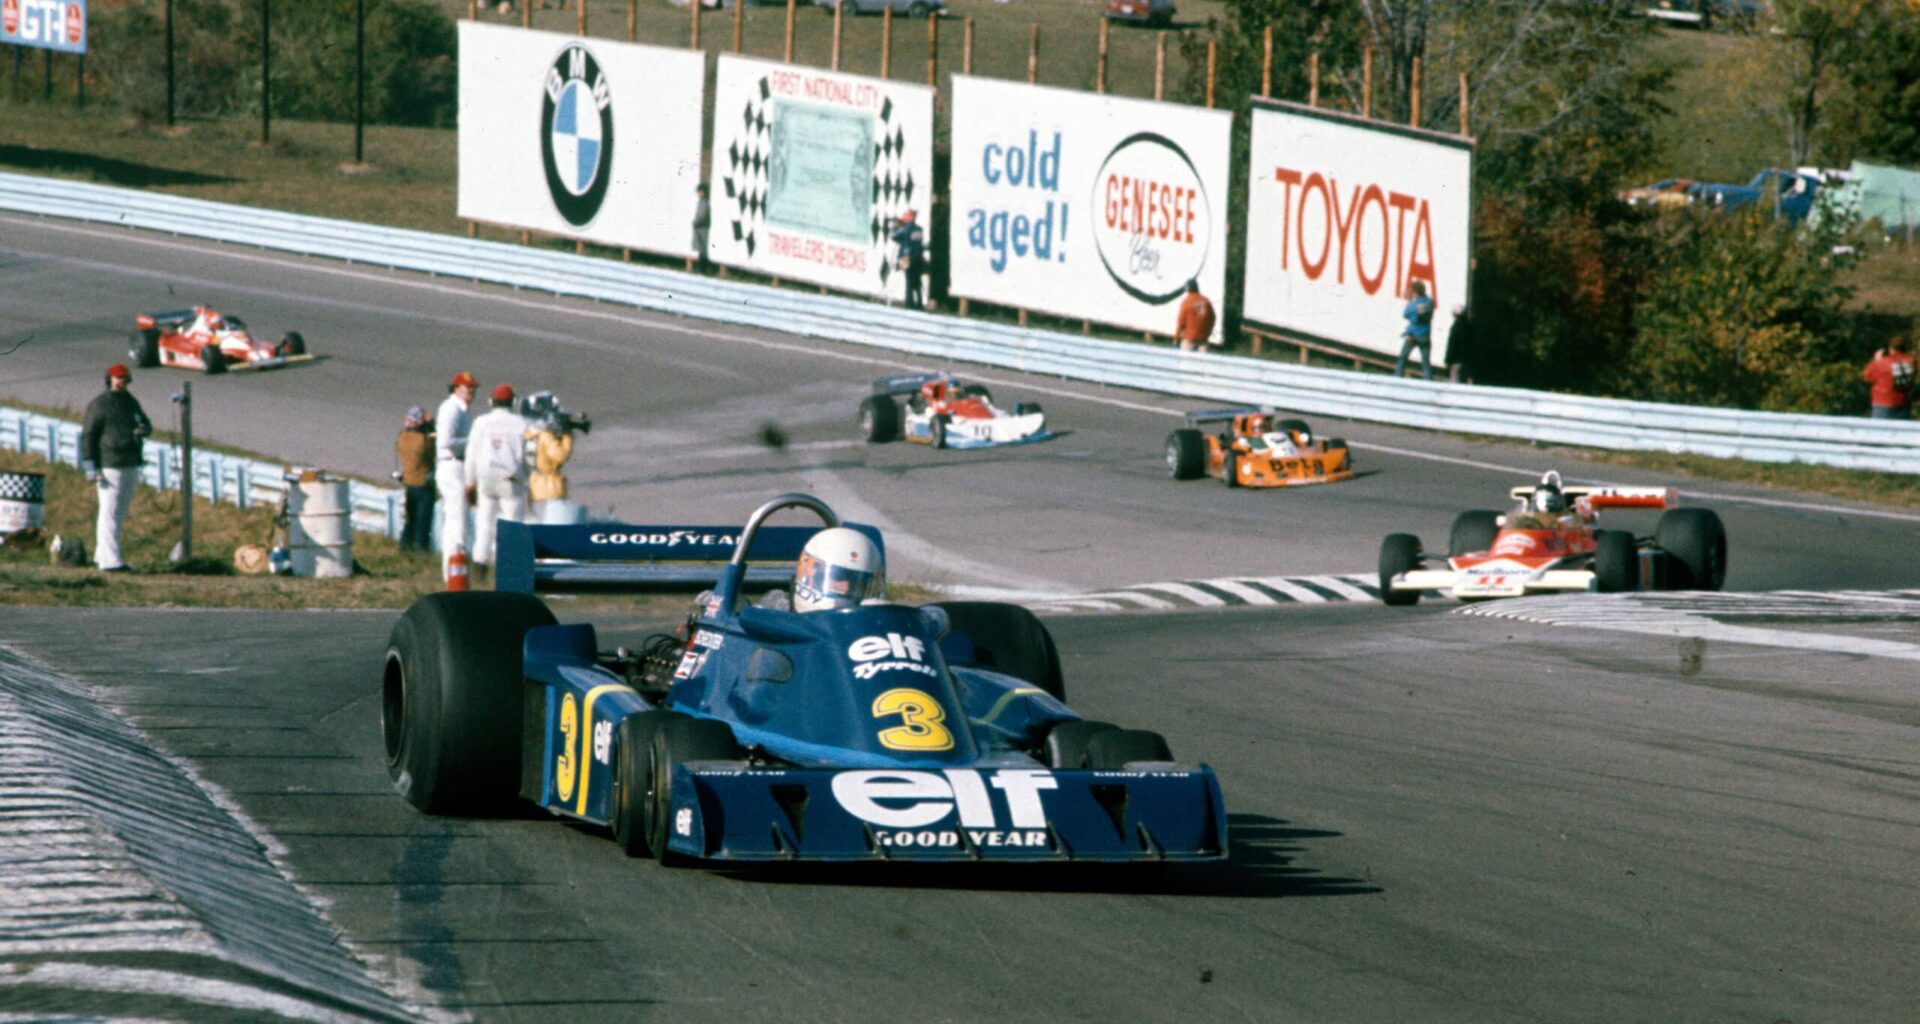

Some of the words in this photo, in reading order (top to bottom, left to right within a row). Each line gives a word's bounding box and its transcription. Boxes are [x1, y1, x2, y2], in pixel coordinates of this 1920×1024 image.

[547, 47, 611, 110] BMW
[771, 70, 801, 95] FIRST
[804, 77, 854, 105] NATIONAL
[856, 83, 880, 109] CITY
[983, 128, 1062, 192] cold
[968, 200, 1069, 273] aged!
[1105, 173, 1196, 244] GENESEE
[1275, 166, 1438, 309] TOYOTA
[768, 232, 823, 263] TRAVELERS
[828, 244, 866, 272] CHECKS
[972, 424, 993, 439] 10
[848, 632, 926, 662] elf
[853, 661, 937, 679] Tyrrell
[557, 692, 577, 802] 3
[594, 720, 613, 766] elf
[872, 688, 955, 751] 3
[831, 769, 1059, 828] elf
